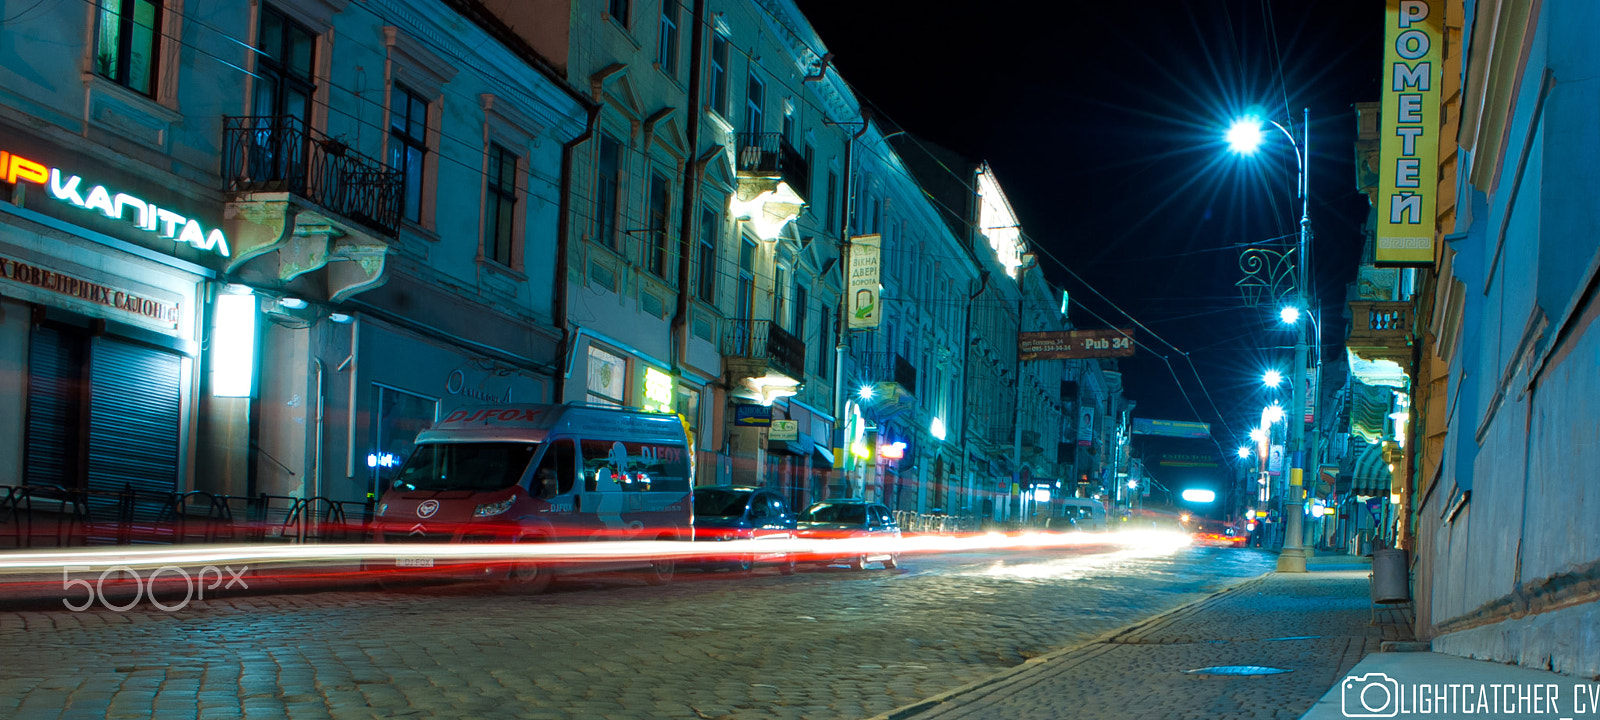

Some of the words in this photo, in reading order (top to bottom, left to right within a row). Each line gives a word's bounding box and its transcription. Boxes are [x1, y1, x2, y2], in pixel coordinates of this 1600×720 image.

[853, 256, 877, 267] ВІКНА
[852, 266, 877, 278] ДВЕРІ
[11, 260, 113, 308] ЮВЕЛІРНИХ
[851, 278, 876, 287] ВОРОТА
[1085, 338, 1109, 350] Pub
[1112, 337, 1129, 349] 34
[444, 408, 544, 423] DJFOX
[641, 445, 681, 465] DJFOX
[550, 503, 573, 513] DJFOX
